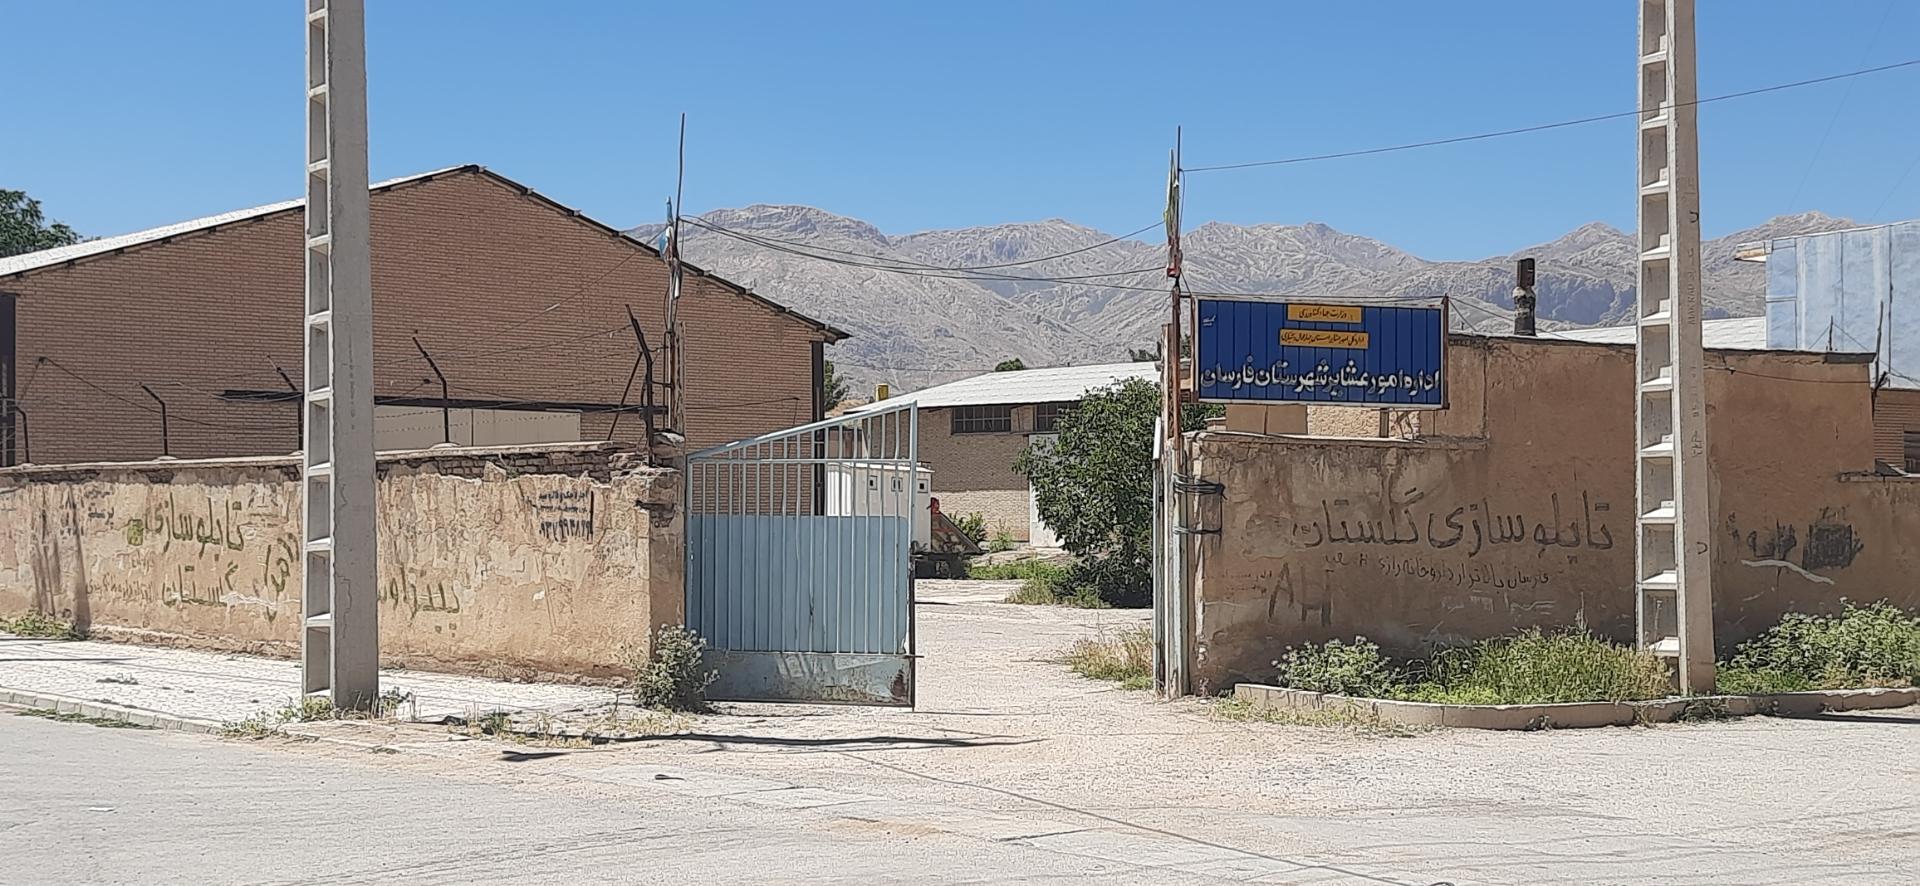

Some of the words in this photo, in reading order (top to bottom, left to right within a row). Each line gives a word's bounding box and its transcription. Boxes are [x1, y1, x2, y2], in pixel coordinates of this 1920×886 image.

[1200, 355, 1255, 390] فارسان
[1254, 359, 1329, 393] شهرستان
[1322, 360, 1369, 396] عشایر
[1367, 369, 1404, 395] امور
[1404, 369, 1439, 396] اداره
[1292, 487, 1425, 548] گلستان
